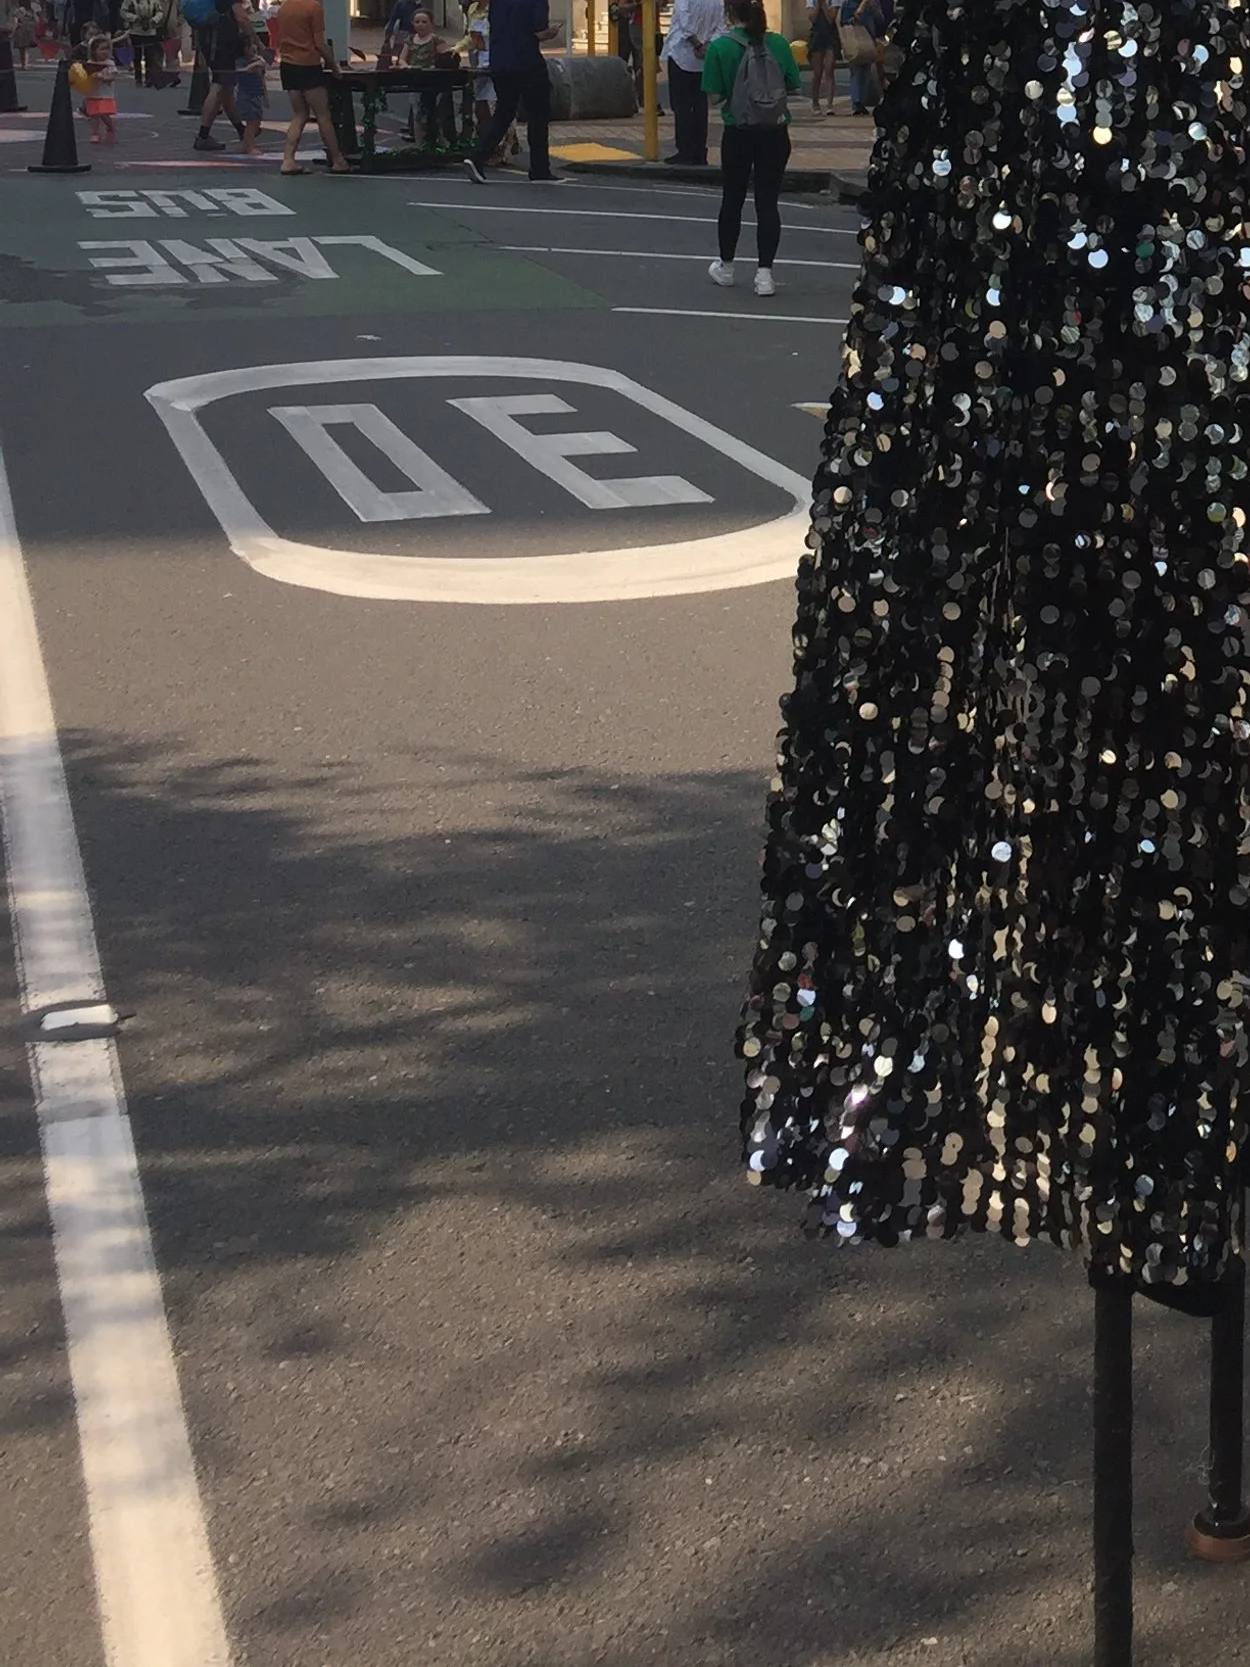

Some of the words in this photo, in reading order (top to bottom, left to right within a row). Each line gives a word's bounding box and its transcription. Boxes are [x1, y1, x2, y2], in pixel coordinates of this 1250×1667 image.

[75, 188, 297, 218] BUS
[76, 235, 443, 284] LANE
[267, 393, 715, 522] 30
